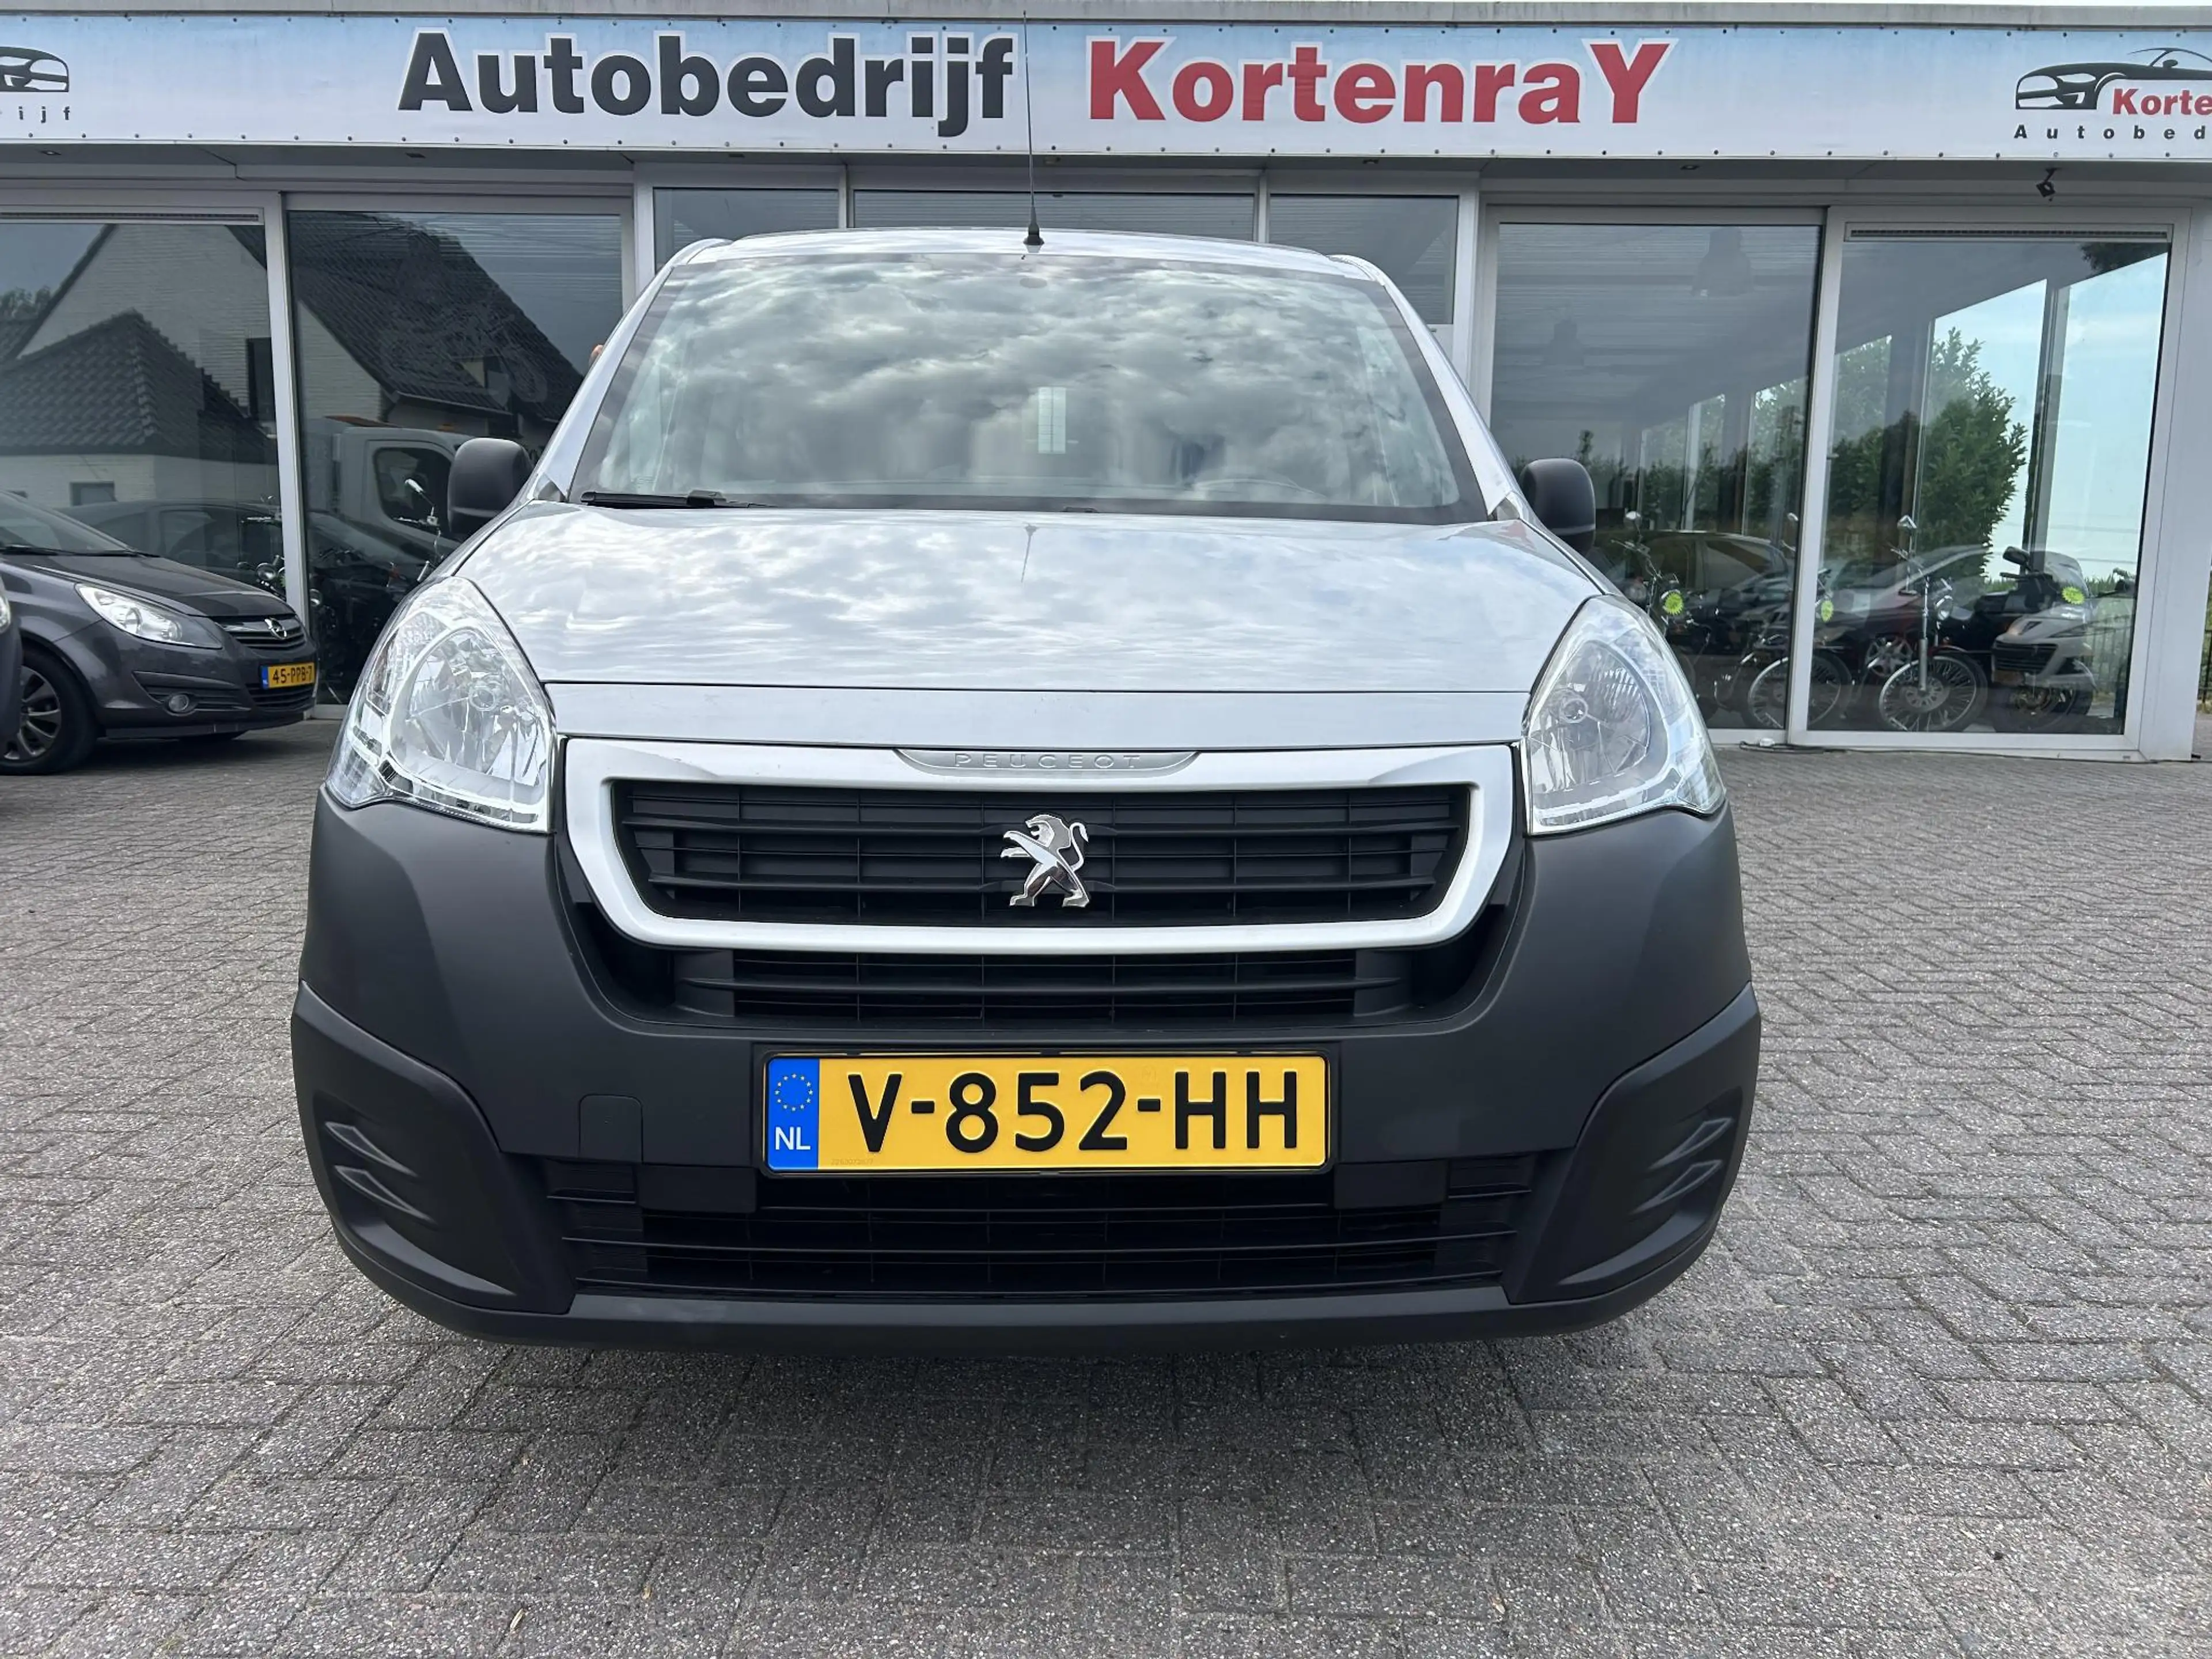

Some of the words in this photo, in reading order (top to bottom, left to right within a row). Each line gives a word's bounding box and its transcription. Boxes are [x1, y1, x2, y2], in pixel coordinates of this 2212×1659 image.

[398, 32, 1013, 137] Autobedrijf
[1090, 41, 1670, 124] KortenraY
[2112, 88, 2212, 115] Korte
[0, 106, 70, 123] ijf
[2014, 124, 2206, 139] Autobed
[272, 665, 312, 684] 45-PPB-7
[848, 1071, 1297, 1153] V-852-HH
[775, 1127, 811, 1150] NL
